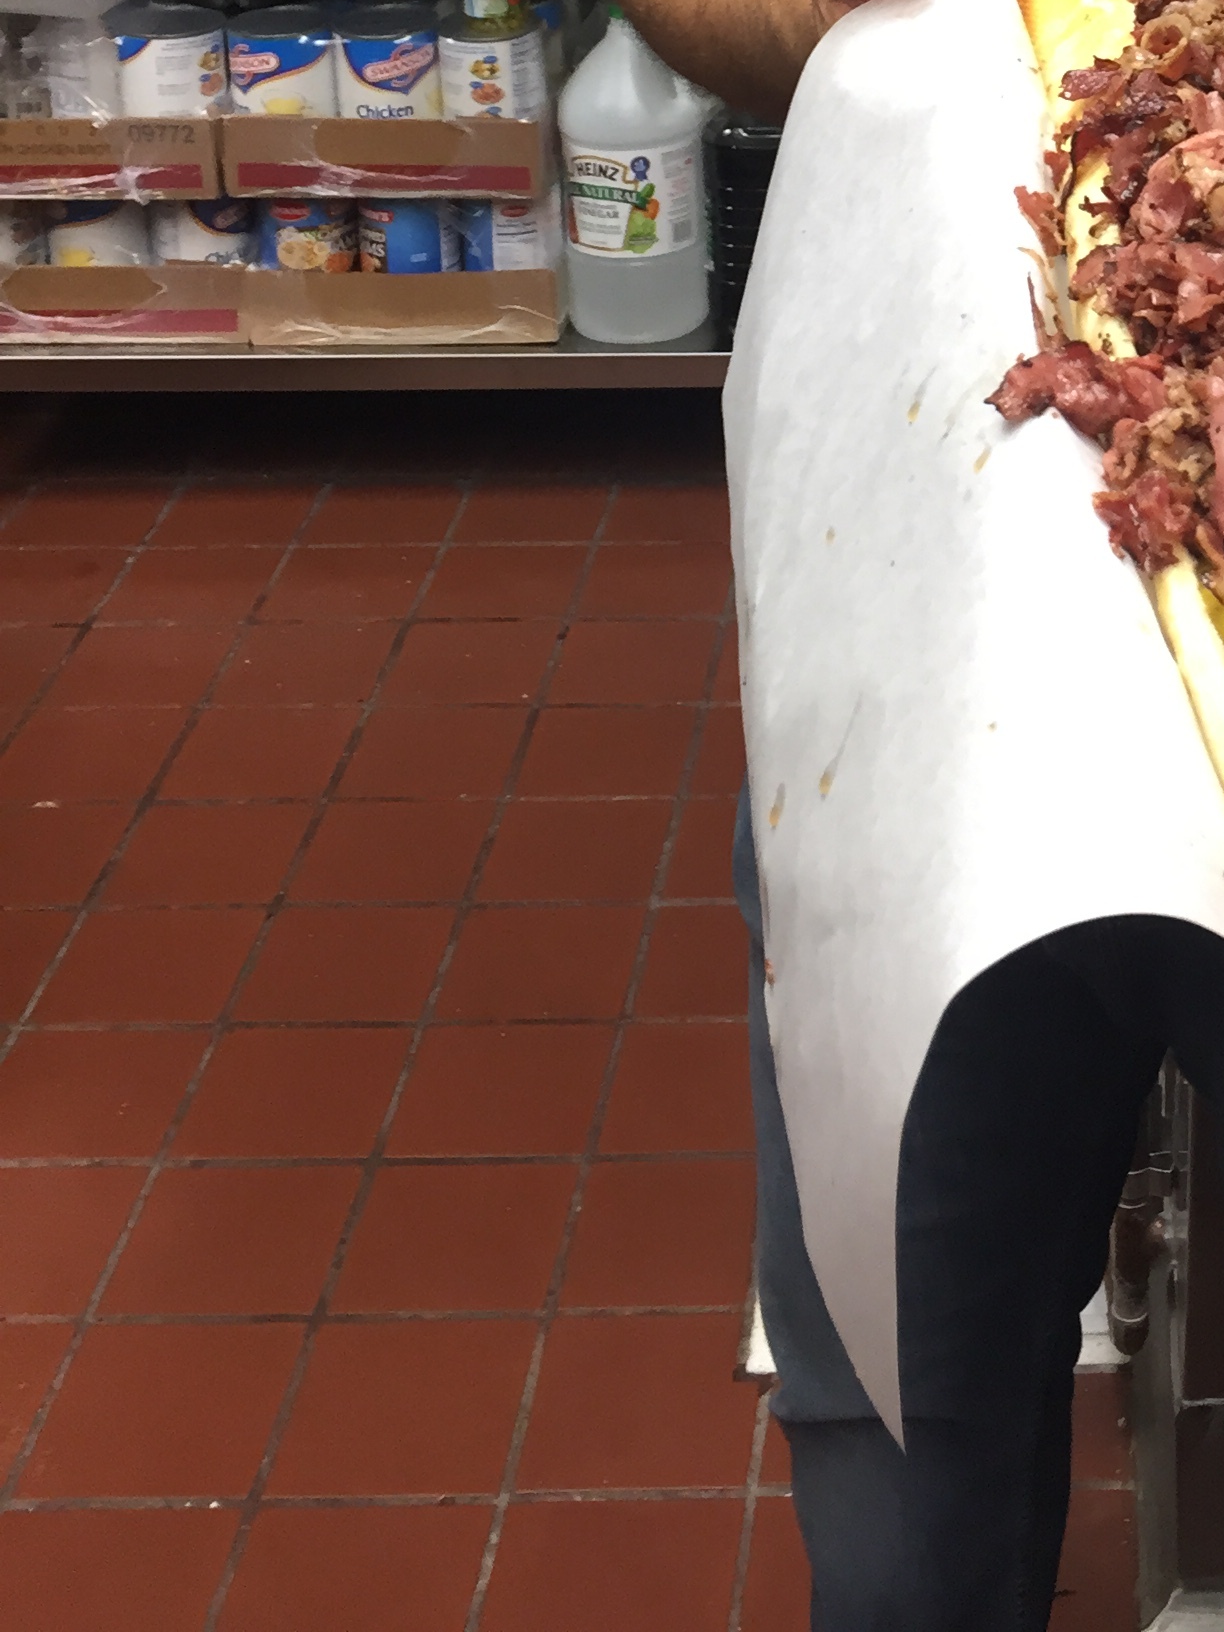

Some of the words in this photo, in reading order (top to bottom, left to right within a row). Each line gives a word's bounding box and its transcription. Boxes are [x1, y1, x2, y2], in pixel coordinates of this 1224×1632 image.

[356, 104, 414, 119] Chicken
[127, 123, 196, 145] 09772
[575, 162, 620, 182] HEINZ
